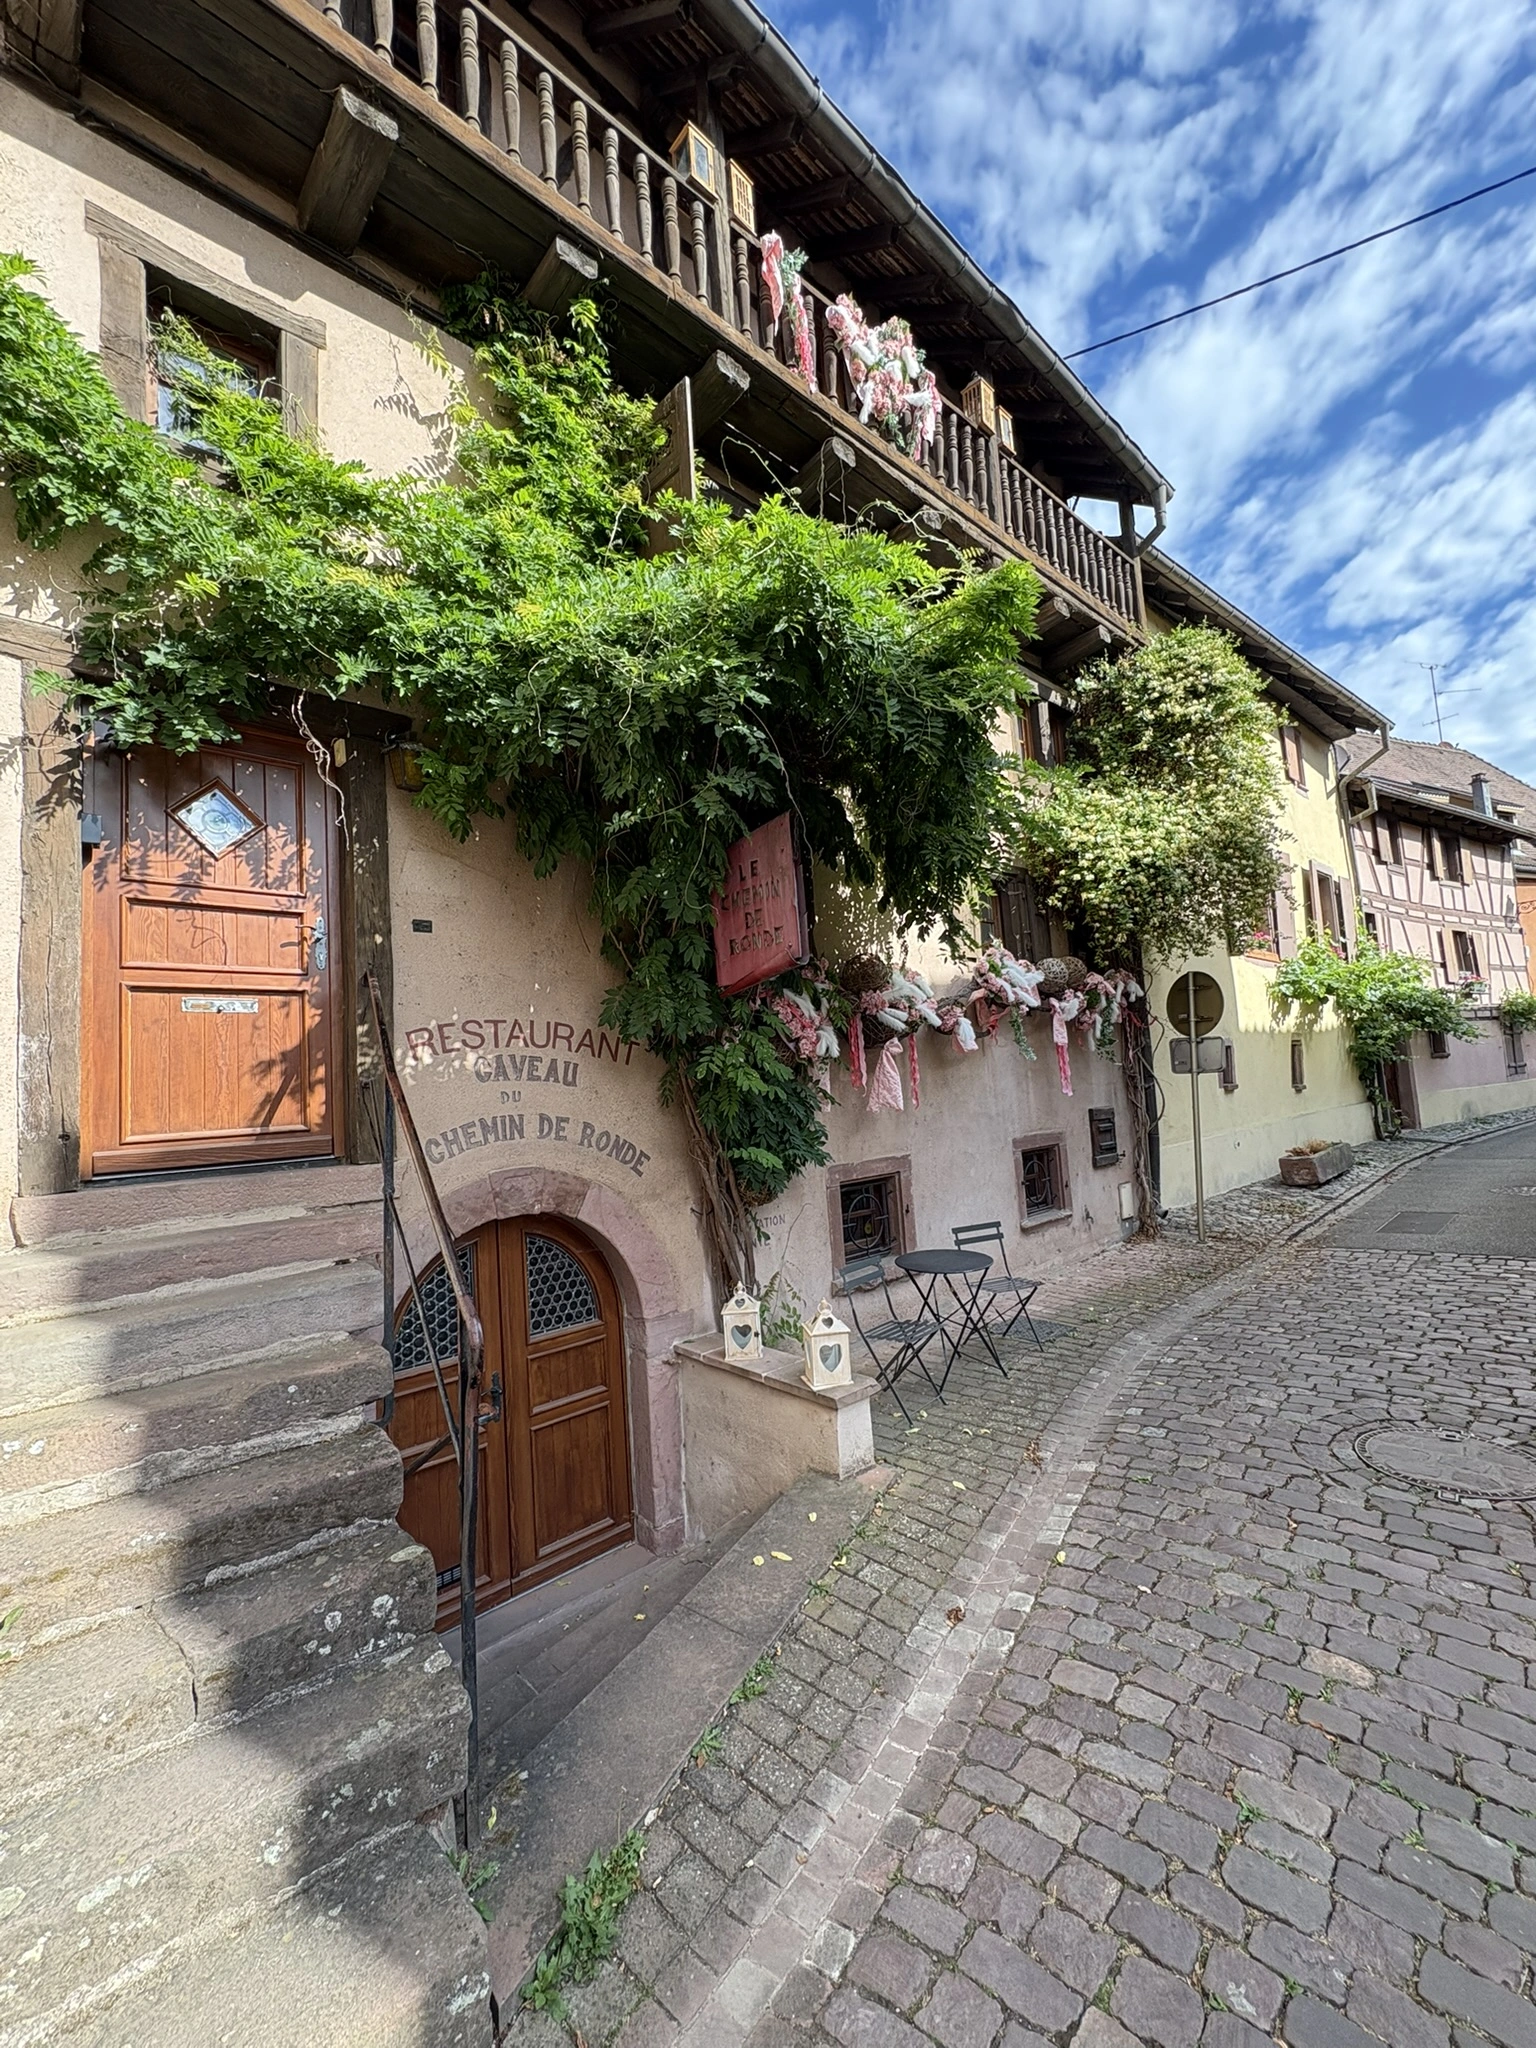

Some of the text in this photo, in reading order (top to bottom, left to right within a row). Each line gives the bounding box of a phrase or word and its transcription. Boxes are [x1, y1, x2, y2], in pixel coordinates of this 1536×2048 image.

[739, 860, 758, 881] LE
[721, 878, 780, 911] CHEMIN
[745, 909, 762, 929] DE
[729, 926, 784, 955] RONDE
[405, 1018, 640, 1065] RESTAURANT
[474, 1054, 579, 1087] CAVEAU
[501, 1090, 521, 1104] DU
[424, 1113, 651, 1177] CHEMIN DE RONDE
